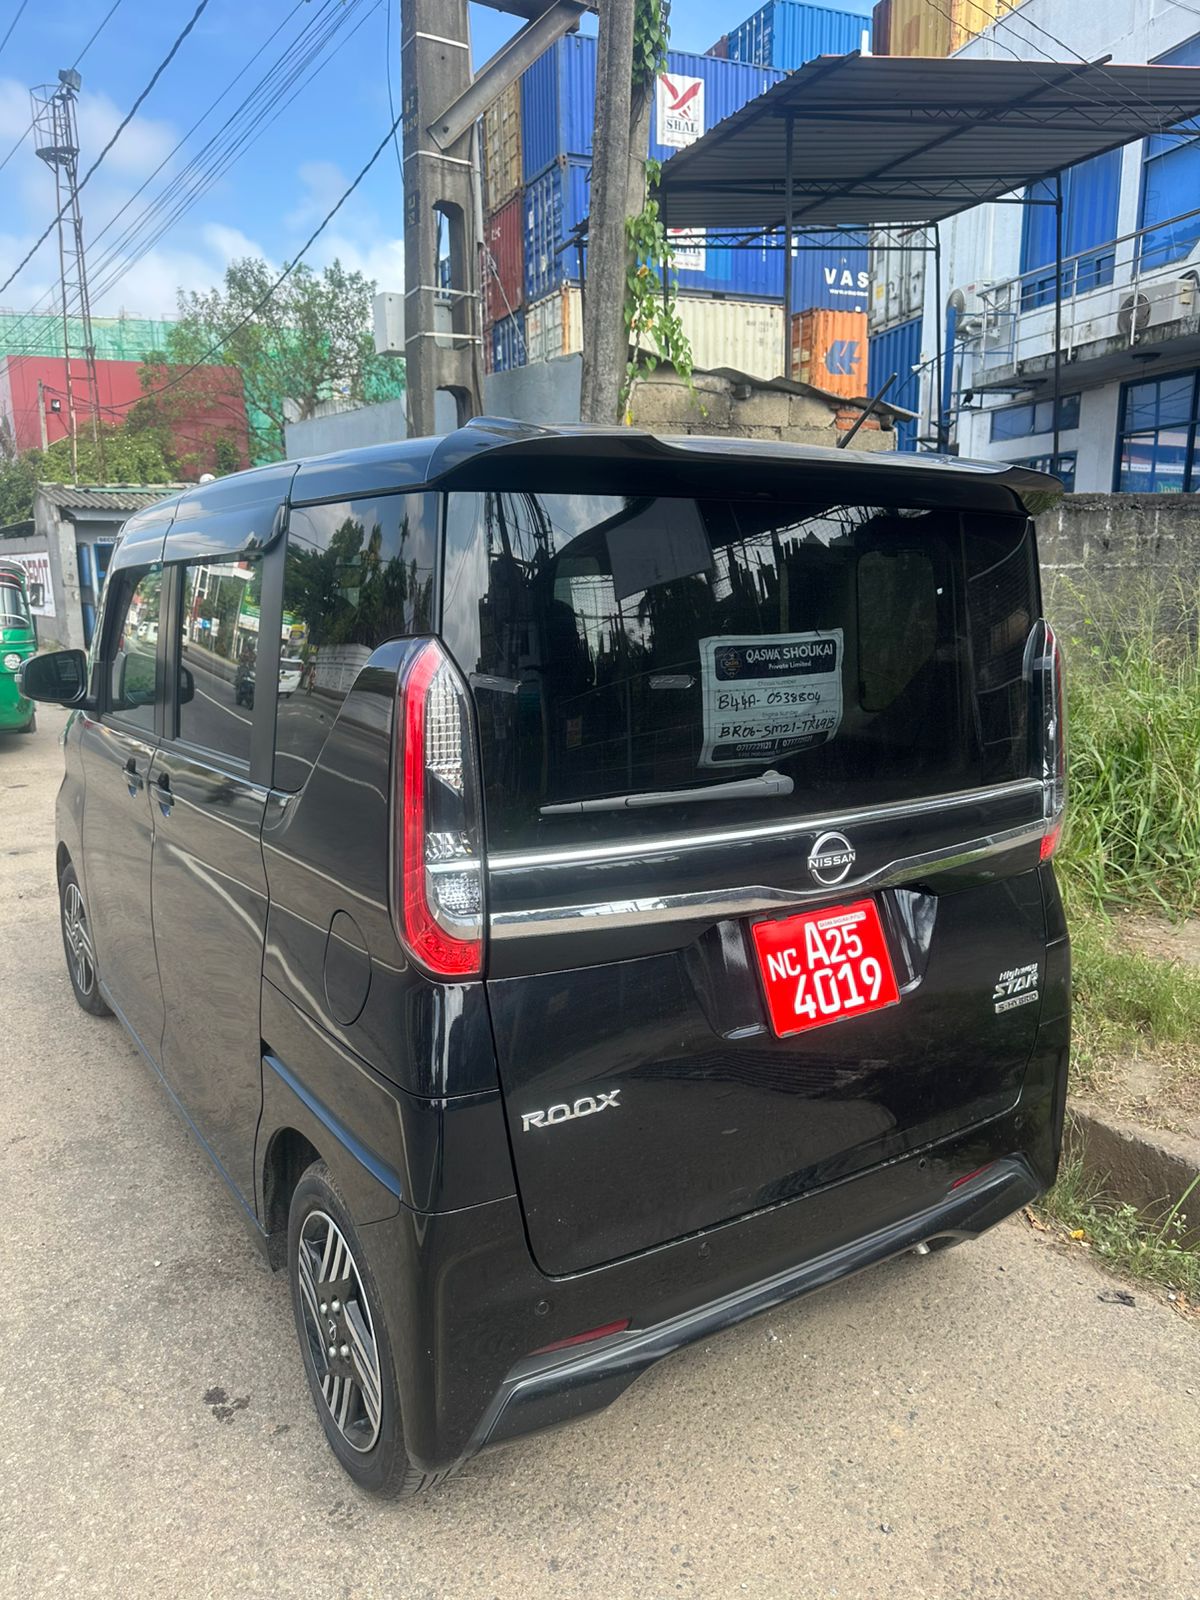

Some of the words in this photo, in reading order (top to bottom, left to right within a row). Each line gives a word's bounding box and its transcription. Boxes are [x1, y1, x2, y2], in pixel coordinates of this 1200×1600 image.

[666, 119, 699, 133] SHAL
[746, 648, 781, 663] QASWA
[783, 643, 833, 660] SHOUKAI
[790, 660, 812, 668] Limited
[808, 852, 856, 869] NISSAN
[766, 948, 802, 982] NC
[804, 921, 863, 970] A25
[999, 962, 1039, 982] Highway
[794, 957, 882, 1019] 4019
[992, 973, 1039, 999] STAR
[521, 1089, 621, 1132] ROOX
